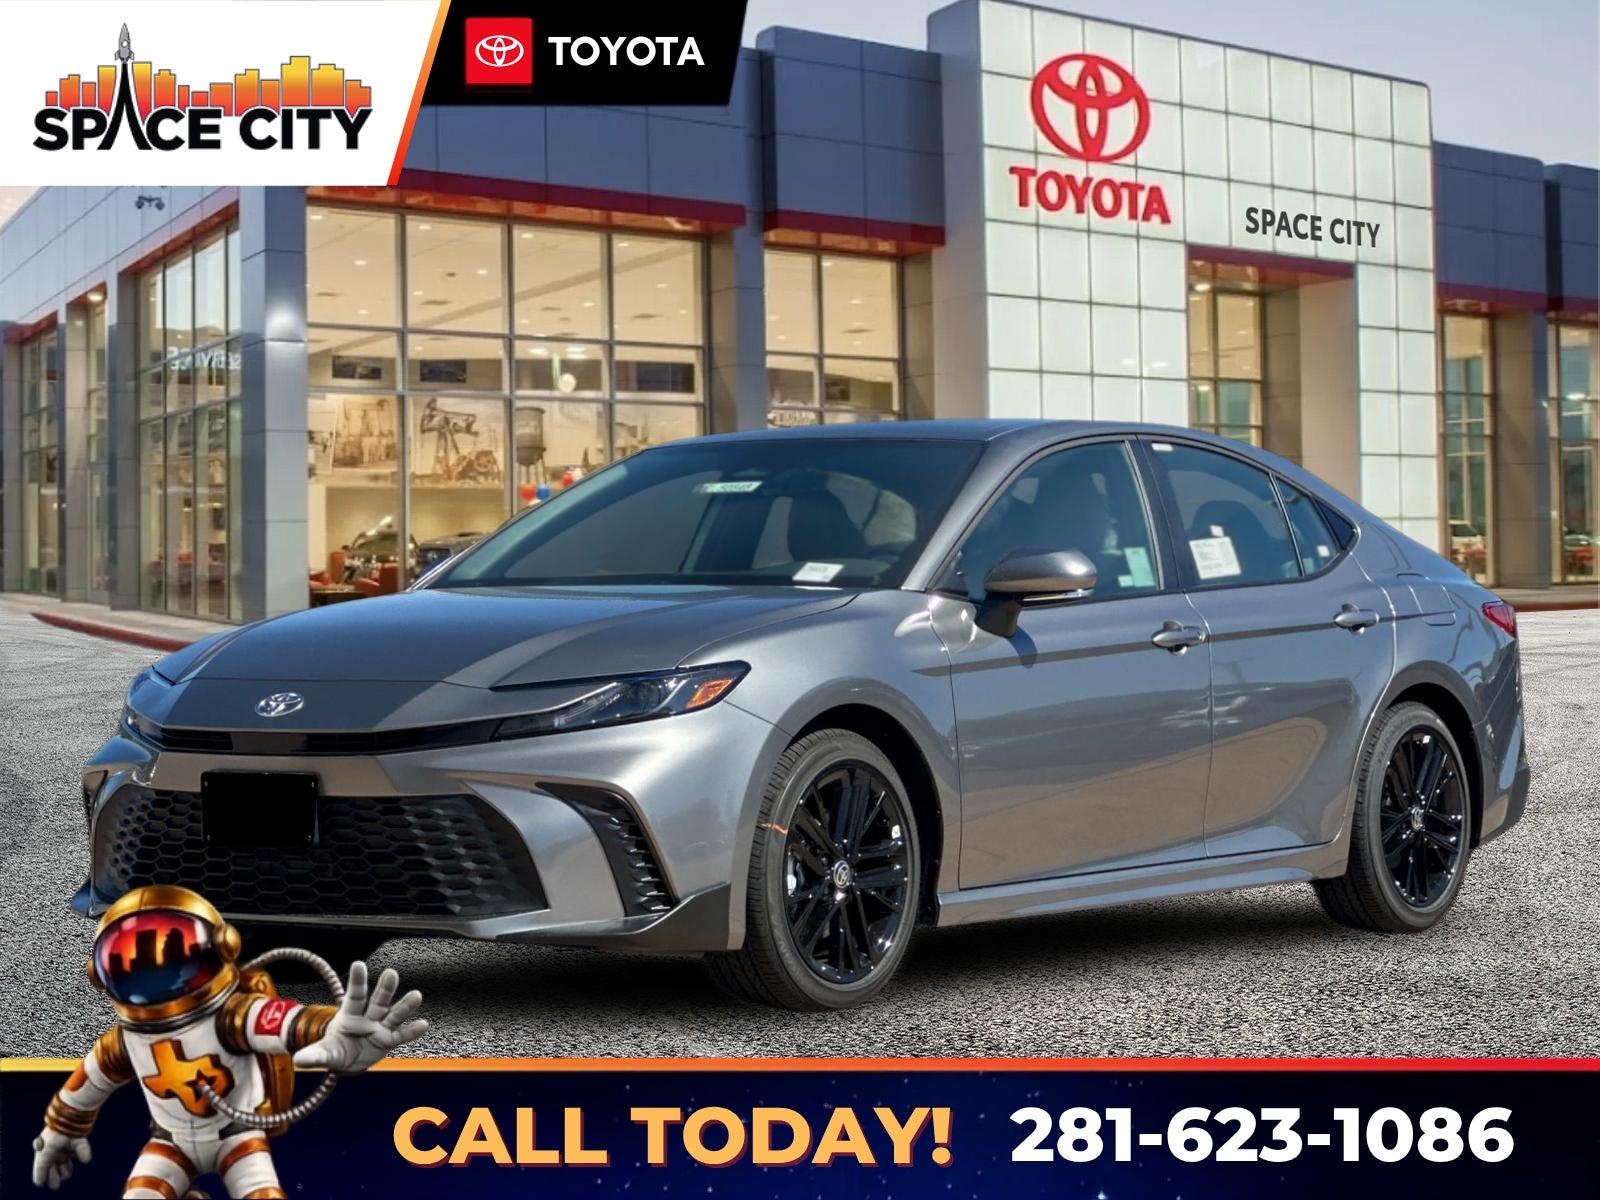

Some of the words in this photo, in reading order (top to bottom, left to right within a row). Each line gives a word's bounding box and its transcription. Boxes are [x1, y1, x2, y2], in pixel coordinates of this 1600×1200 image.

[1009, 166, 1171, 224] TOYOTA
[1245, 206, 1323, 242] SPACE
[1329, 217, 1380, 249] CITY
